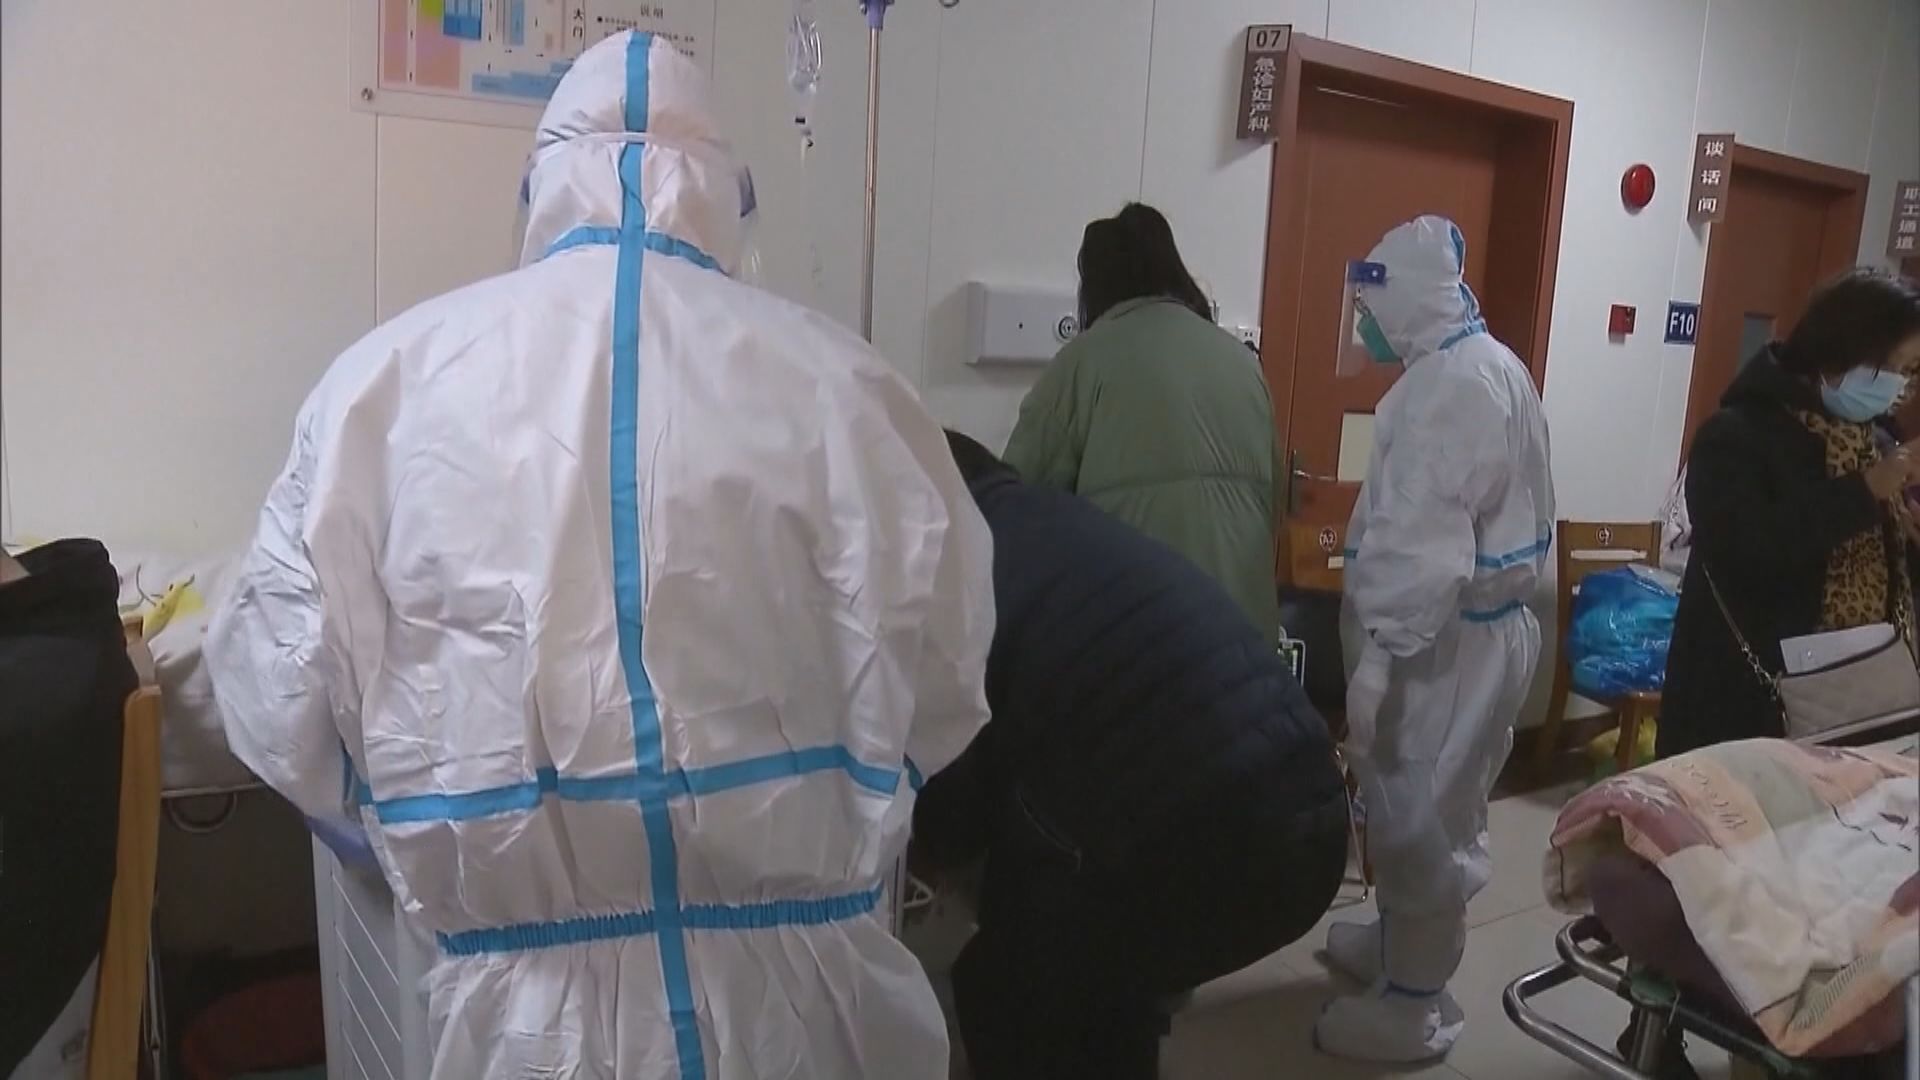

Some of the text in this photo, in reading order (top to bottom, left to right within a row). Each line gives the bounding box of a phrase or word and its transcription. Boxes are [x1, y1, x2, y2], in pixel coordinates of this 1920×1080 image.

[1256, 30, 1281, 48] 07
[1247, 57, 1276, 132] 急诊妇产科
[1697, 141, 1725, 213] 谈话间
[1669, 311, 1695, 335] F10
